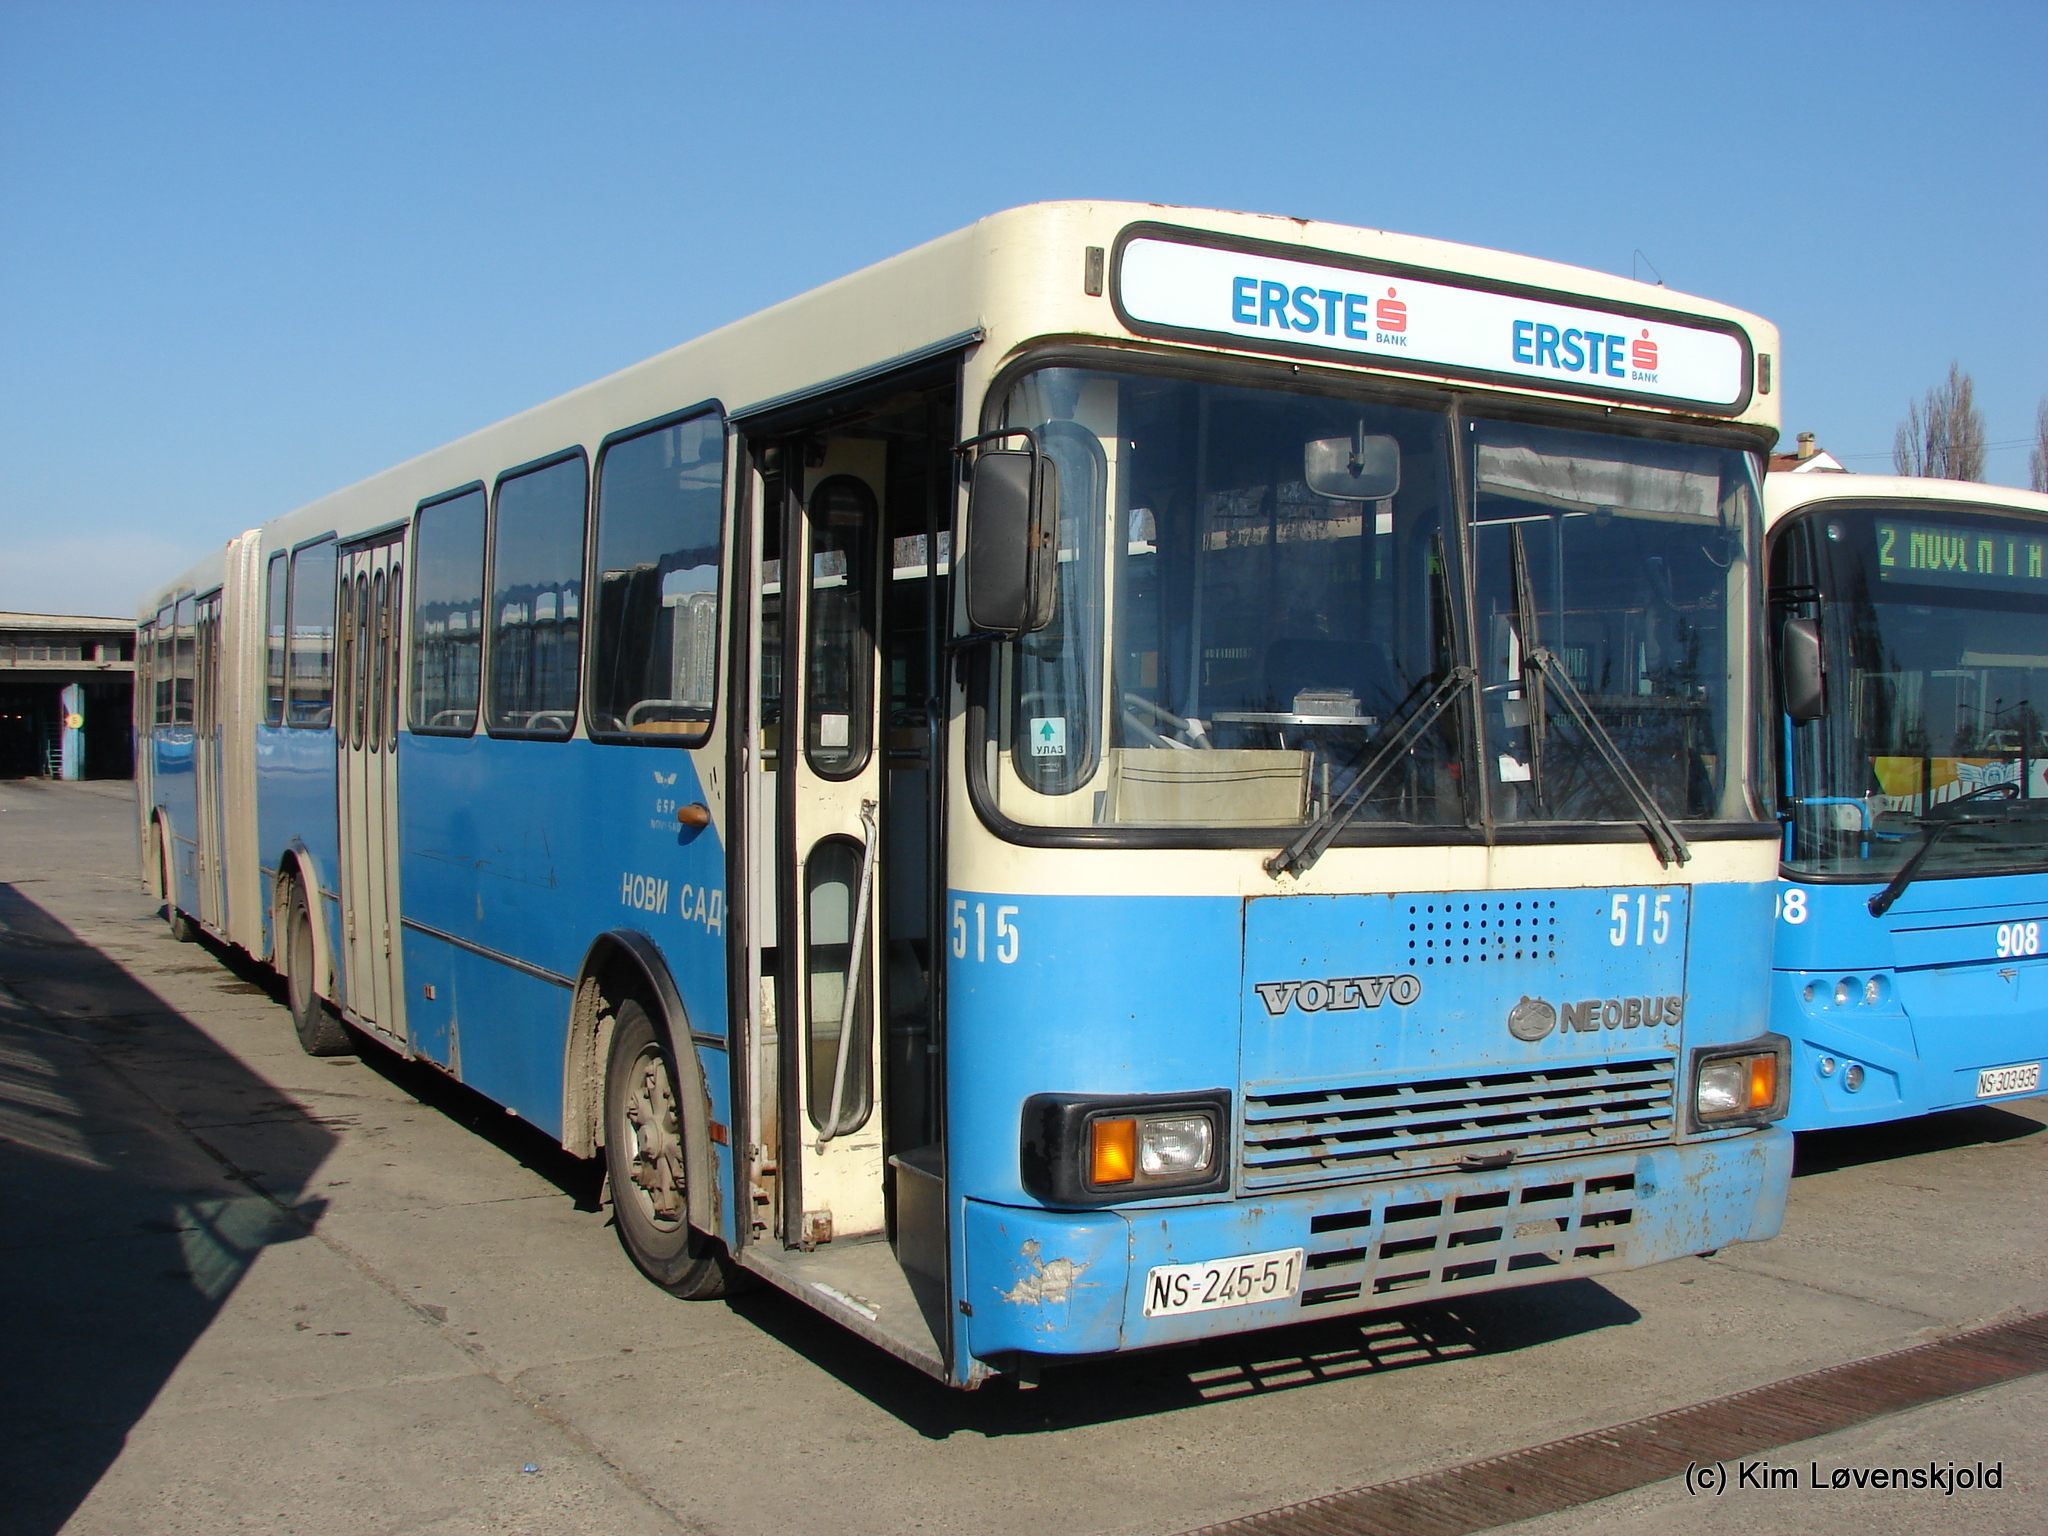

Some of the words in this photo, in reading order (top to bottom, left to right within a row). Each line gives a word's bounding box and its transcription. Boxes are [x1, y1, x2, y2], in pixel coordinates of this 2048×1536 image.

[1232, 276, 1368, 340] ERSTE
[1375, 333, 1408, 347] BANK
[1512, 319, 1626, 378] ERSTE
[1631, 370, 1659, 384] BANK
[1880, 528, 1896, 567] 2
[1036, 745, 1064, 754] УЛАЗ
[656, 798, 675, 814] GSP
[621, 872, 669, 914] НОВИ
[681, 884, 723, 936] САД
[1610, 893, 1671, 946] 515
[953, 900, 1020, 964] 515
[1996, 921, 2039, 957] 908
[1255, 974, 1422, 1015] VOLVO
[1560, 995, 1682, 1034] NEOBUS
